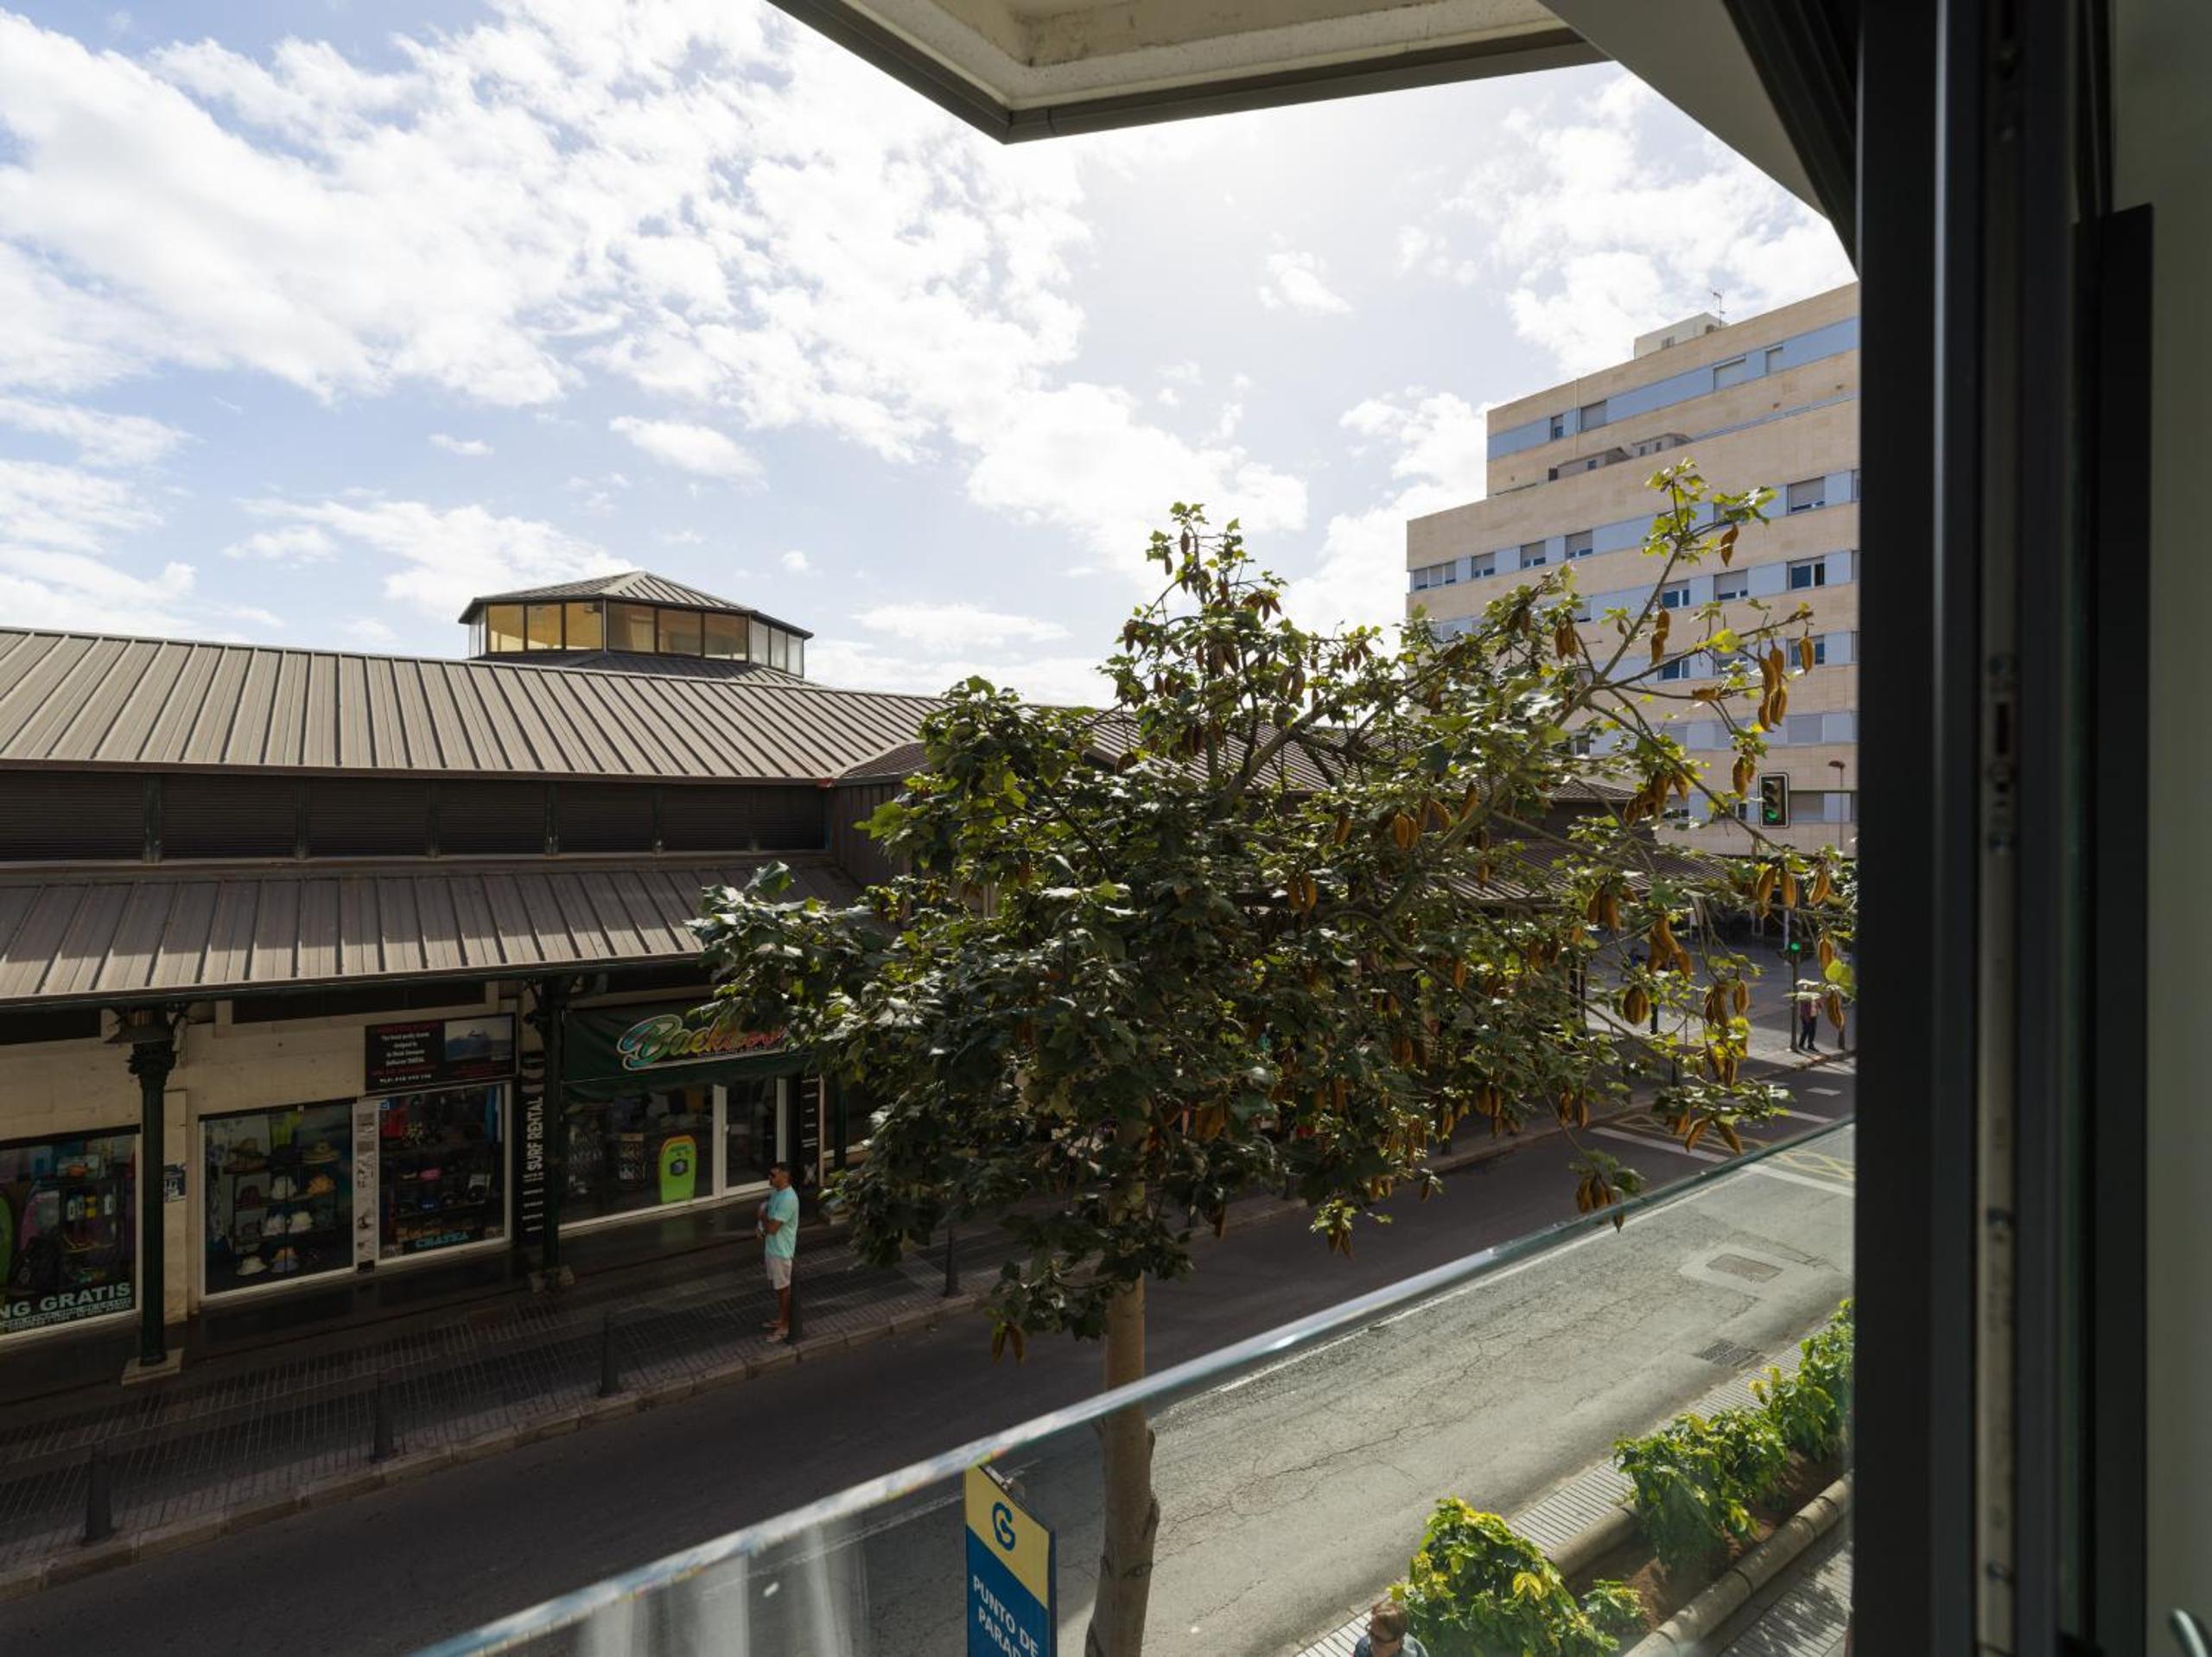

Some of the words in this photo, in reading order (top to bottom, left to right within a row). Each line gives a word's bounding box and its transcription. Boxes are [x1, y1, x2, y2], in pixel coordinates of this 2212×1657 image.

[527, 1096, 544, 1140] RENTAL
[527, 1143, 544, 1171] SURF
[39, 1282, 131, 1311] GRATIS
[973, 1574, 1016, 1635] PUNTO
[1020, 1626, 1039, 1657] DE
